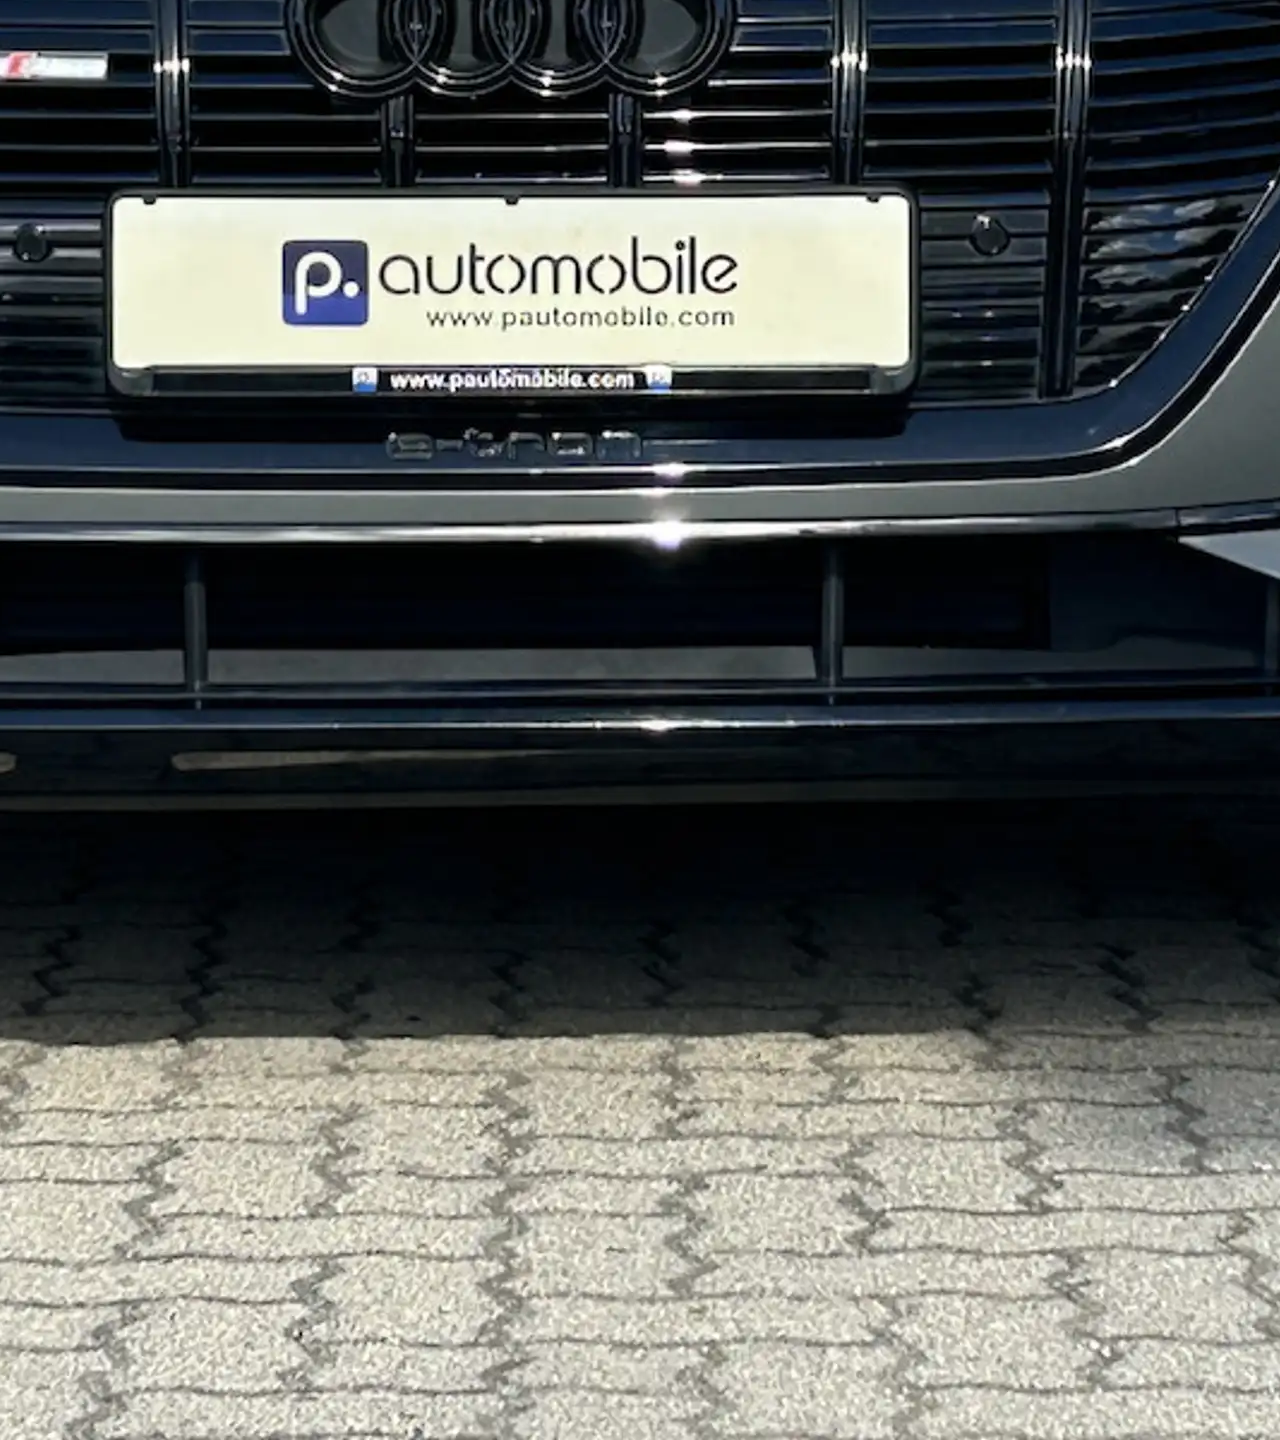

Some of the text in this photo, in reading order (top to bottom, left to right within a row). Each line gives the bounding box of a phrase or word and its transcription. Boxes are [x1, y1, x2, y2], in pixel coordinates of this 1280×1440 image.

[379, 237, 737, 294] automobile
[427, 307, 733, 329] www.pautomobile.com
[390, 367, 635, 392] www.pautomobile.com
